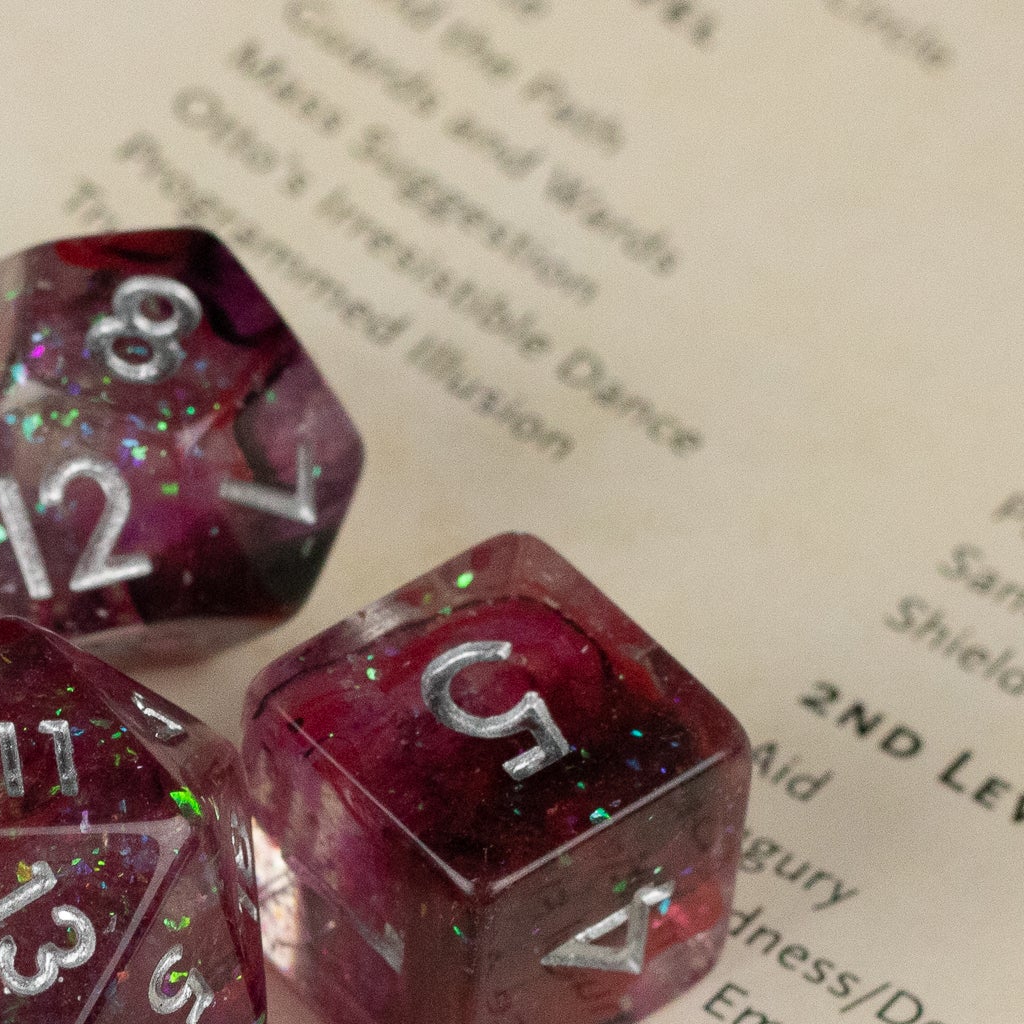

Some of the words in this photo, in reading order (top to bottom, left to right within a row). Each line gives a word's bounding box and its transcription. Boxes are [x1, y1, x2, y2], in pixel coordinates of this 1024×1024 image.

[356, 122, 599, 305] Suggestion
[86, 274, 203, 384] 8
[316, 188, 552, 358] Irresistible
[556, 345, 706, 457] Dance
[406, 335, 576, 460] Illusion
[420, 640, 571, 781] 5
[753, 740, 834, 802] Aid
[799, 679, 924, 761] 2ND
